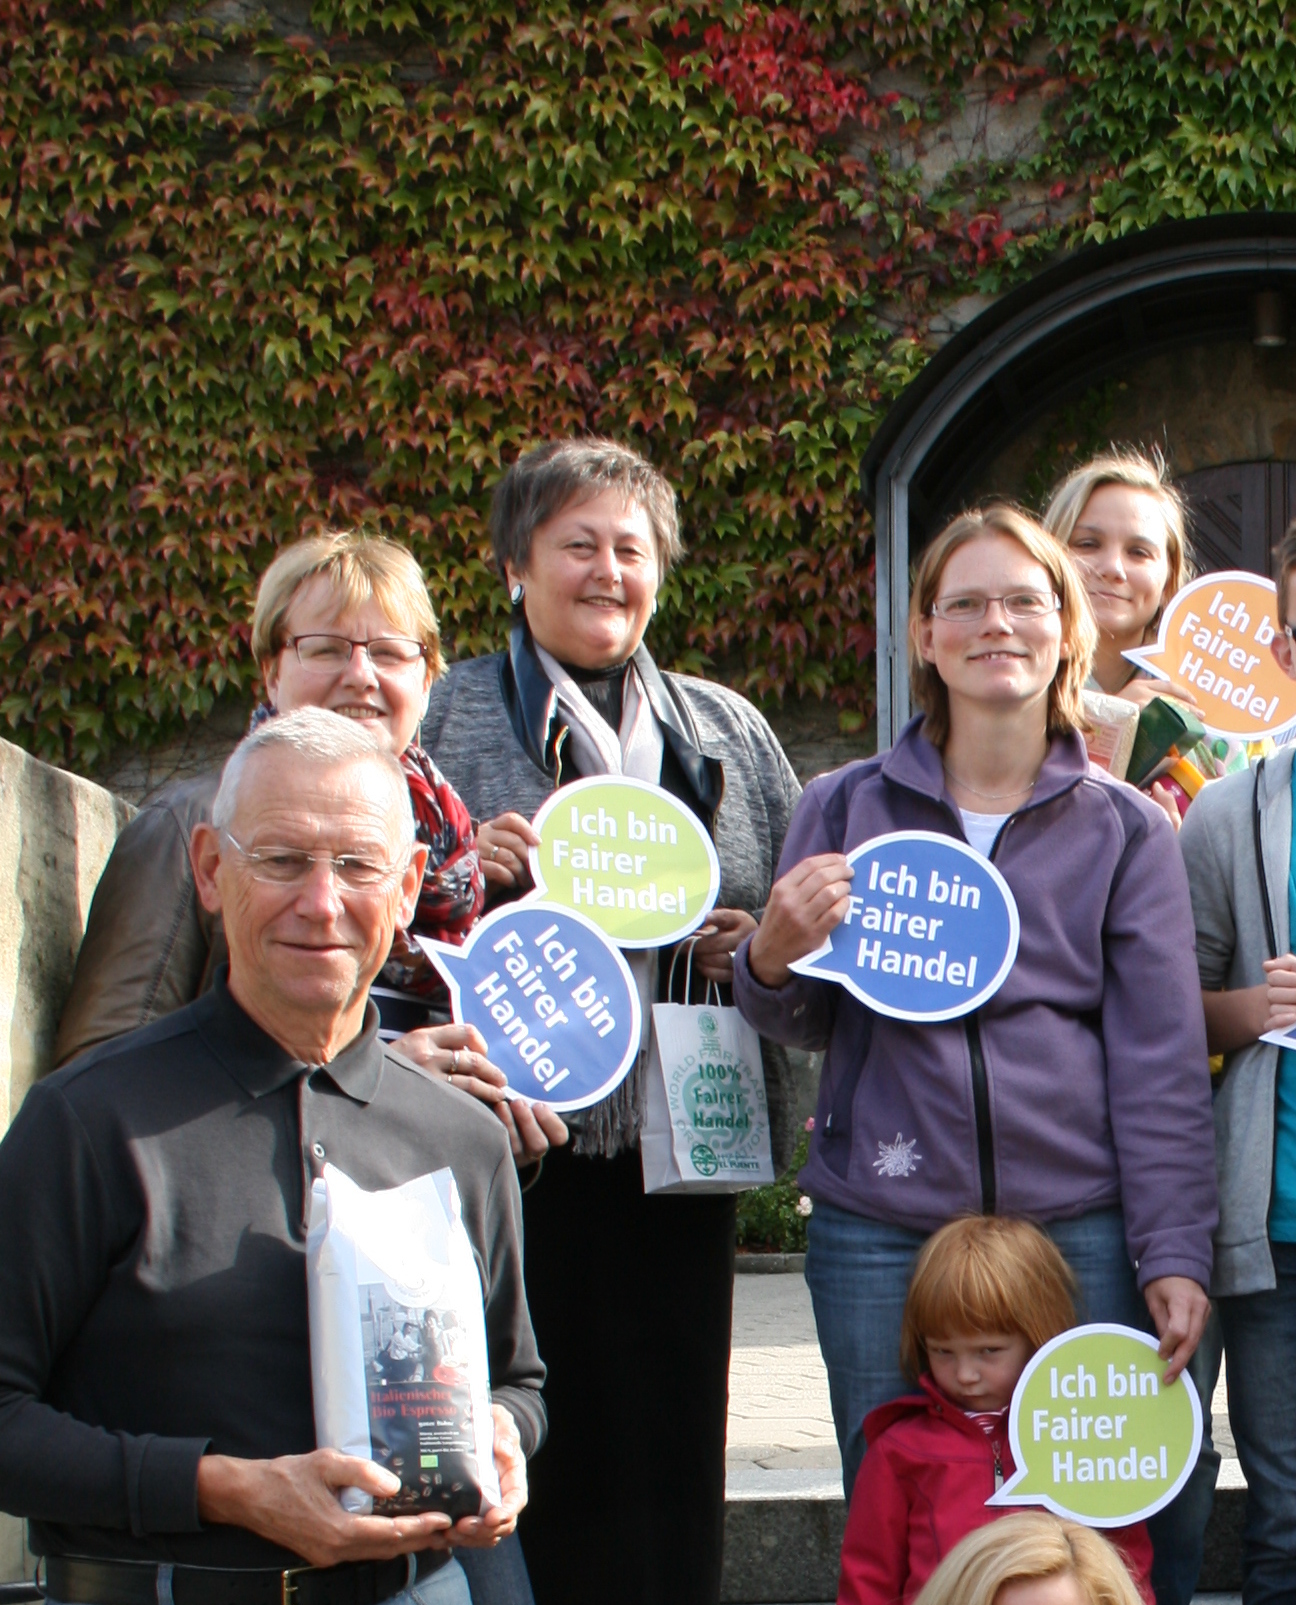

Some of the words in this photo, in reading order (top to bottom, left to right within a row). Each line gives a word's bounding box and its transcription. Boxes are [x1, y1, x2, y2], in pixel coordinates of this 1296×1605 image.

[1208, 590, 1250, 634] Ich
[1179, 612, 1260, 674] Fairer
[1178, 651, 1279, 723] Handel
[571, 806, 617, 838] Ich
[628, 811, 677, 845] bin
[553, 839, 647, 875] Fairer
[573, 877, 686, 916] Handel
[869, 861, 917, 898] Ich
[928, 870, 980, 909] bin
[844, 895, 943, 941] Fairer
[493, 930, 568, 1028] Fairer
[534, 924, 578, 982] Ich
[571, 976, 616, 1038] bin
[857, 938, 978, 988] Handel
[474, 972, 570, 1092] Handel
[669, 1055, 696, 1111] WORLD
[698, 1063, 742, 1080] 100%
[694, 1086, 743, 1104] Fairer
[693, 1111, 749, 1128] Handel
[1050, 1364, 1096, 1399] Ich
[1107, 1364, 1159, 1397] bin
[401, 1404, 457, 1418] Espresso
[1033, 1407, 1127, 1441] Fairer
[1052, 1446, 1167, 1483] Handel
